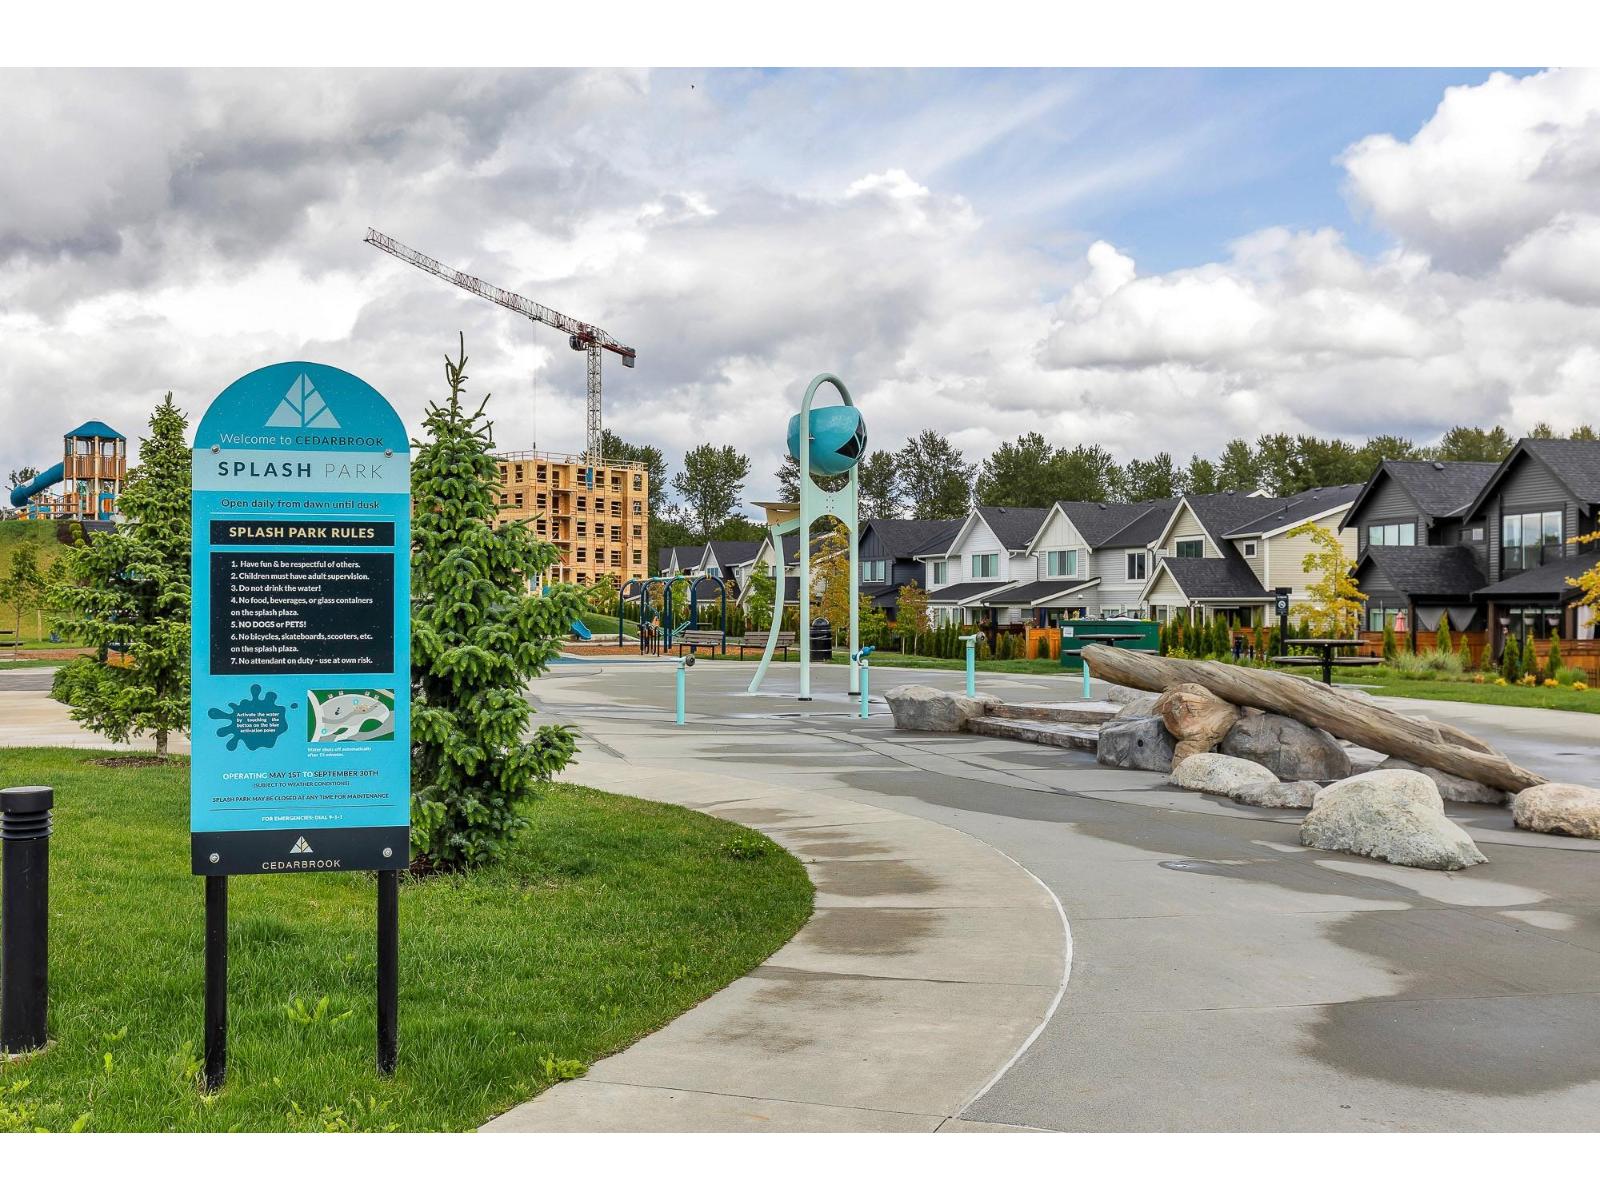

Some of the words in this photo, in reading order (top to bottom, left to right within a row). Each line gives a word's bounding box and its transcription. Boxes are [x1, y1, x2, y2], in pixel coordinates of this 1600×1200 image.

[220, 434, 276, 445] Welcome
[280, 436, 292, 445] to
[296, 436, 383, 446] CEDARBROOK
[218, 461, 311, 478] SPLASH
[325, 463, 383, 480] PARK
[222, 499, 248, 509] Open
[252, 500, 274, 510] daily
[278, 500, 300, 508] from
[304, 500, 330, 508] dawn
[332, 500, 354, 509] until
[357, 500, 380, 509] dusk
[229, 526, 284, 538] SPLASH
[288, 527, 327, 538] PARK
[331, 528, 374, 538] RULES
[328, 573, 370, 581] supervision.
[270, 597, 308, 605] beverages,
[318, 597, 335, 605] glass
[262, 859, 341, 870] CEDARBROOK
